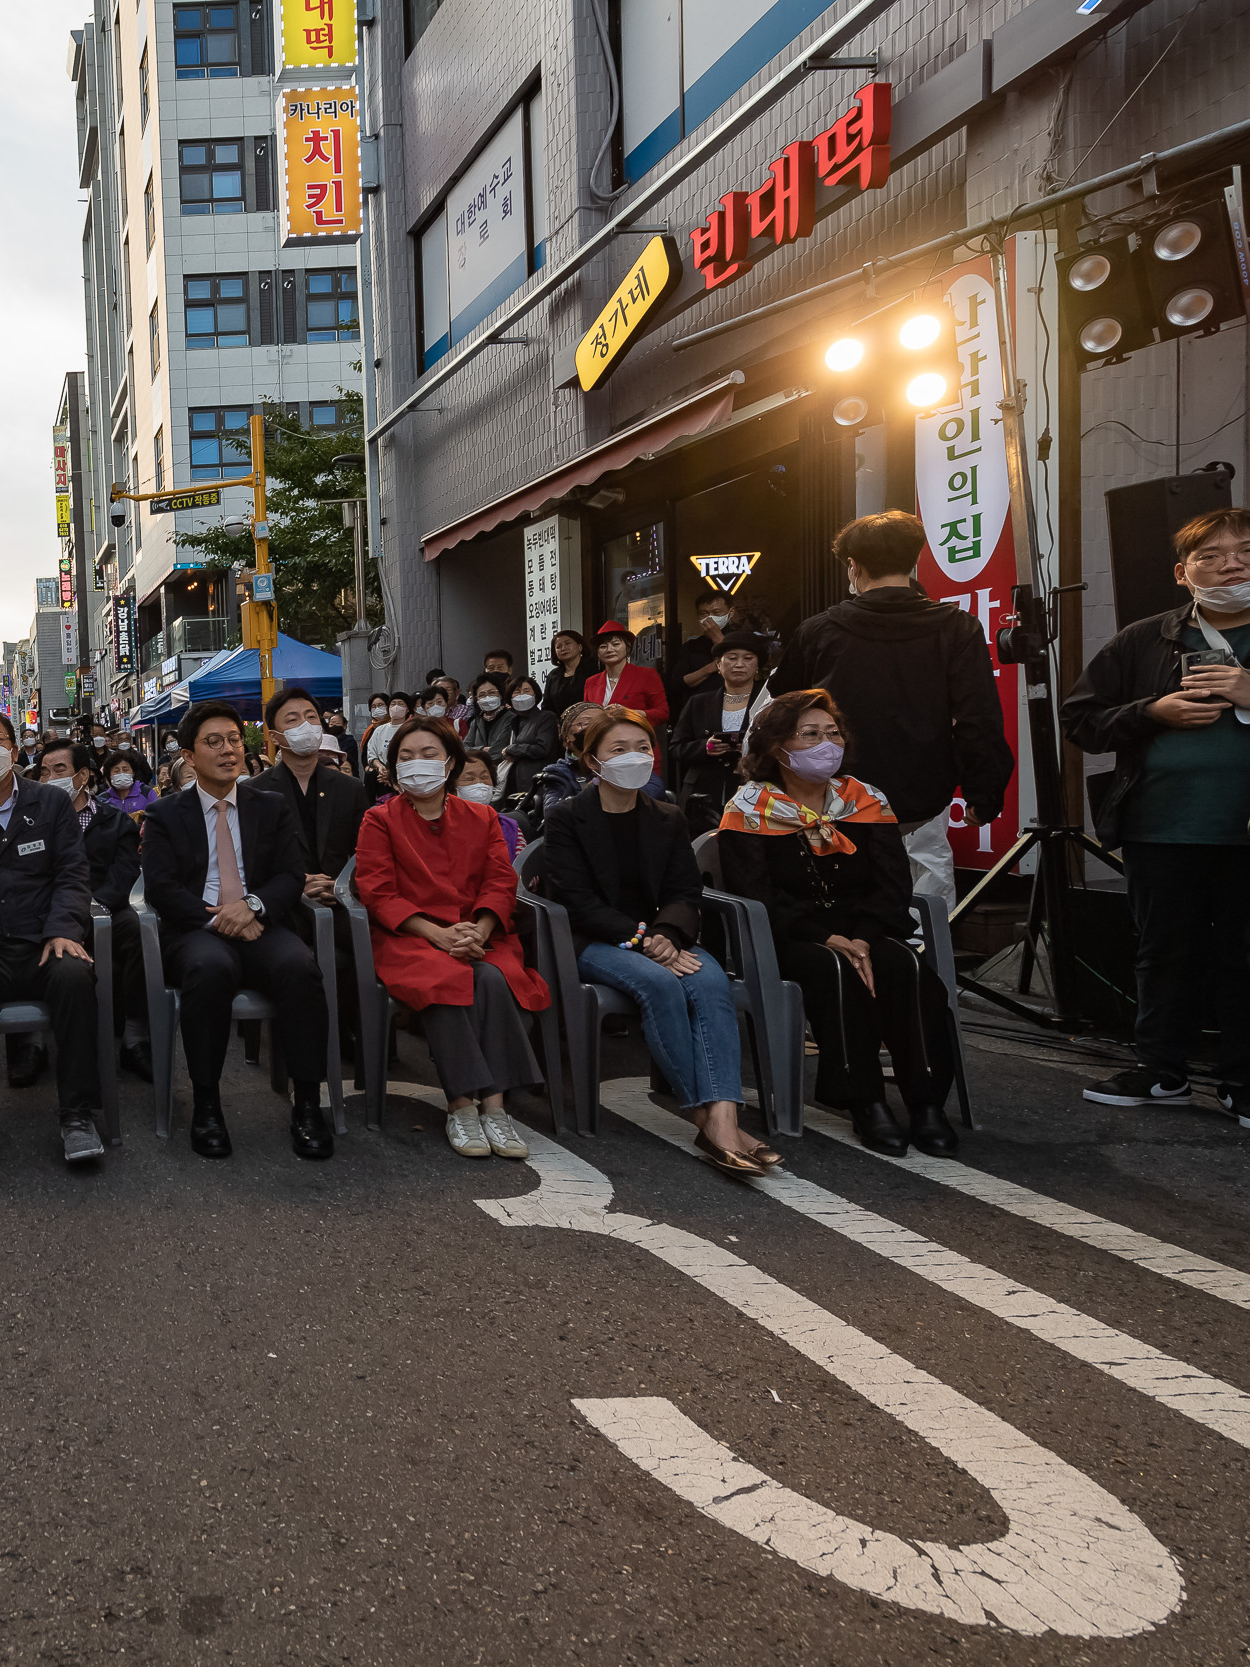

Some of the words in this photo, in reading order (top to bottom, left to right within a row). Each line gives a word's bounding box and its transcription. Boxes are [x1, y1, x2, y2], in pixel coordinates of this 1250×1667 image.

[289, 100, 356, 121] 카나리아
[303, 128, 345, 226] 치킨
[690, 82, 890, 290] 빈대떡
[456, 155, 513, 237] 대한예수교
[590, 264, 651, 360] 정가네
[55, 445, 67, 486] 마사지
[171, 497, 193, 509] CCTV
[194, 492, 218, 506] 작동중
[526, 523, 557, 553] 녹두빈대떡
[696, 555, 752, 578] TERRA
[528, 595, 558, 620] 오징어데침
[117, 606, 130, 656] 강남촌닭
[530, 646, 553, 666] 벌교꼬
